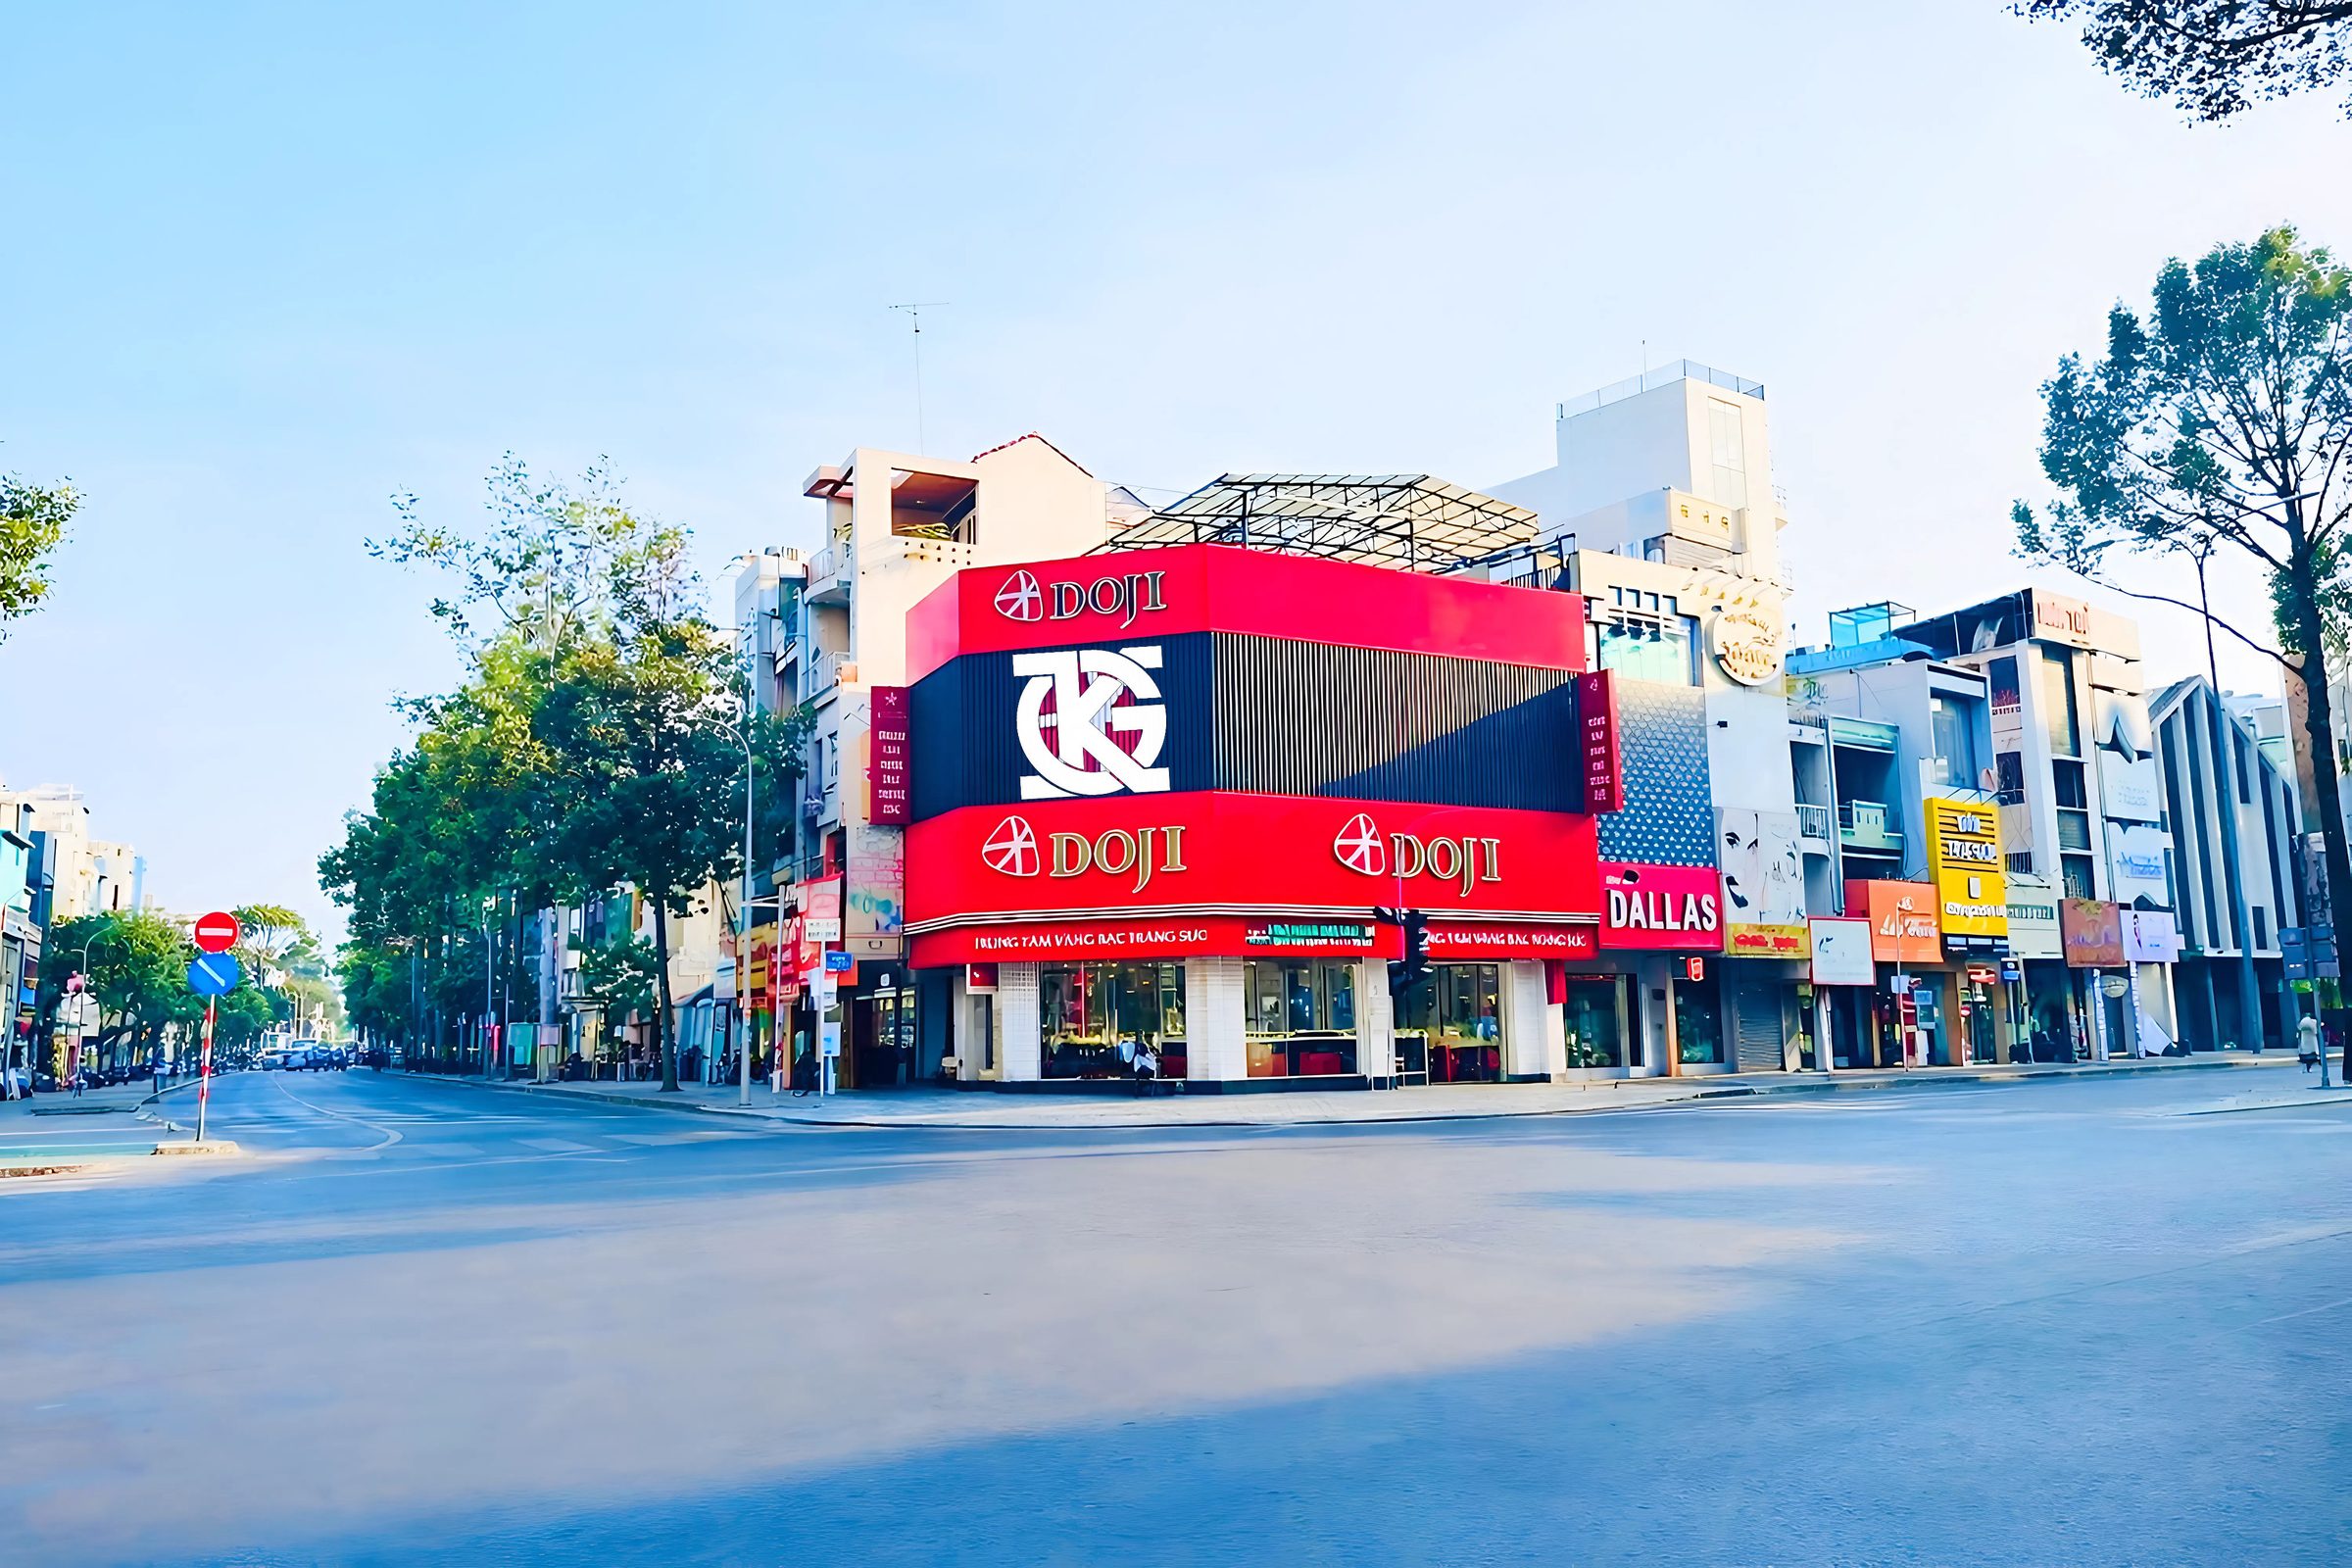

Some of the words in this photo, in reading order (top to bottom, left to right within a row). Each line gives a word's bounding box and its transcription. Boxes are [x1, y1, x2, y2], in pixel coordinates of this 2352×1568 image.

[1049, 570, 1168, 630] DOJI
[1049, 825, 1188, 894] DOJI
[1390, 833, 1502, 898] DOJI
[1609, 888, 1718, 932] DALLAS
